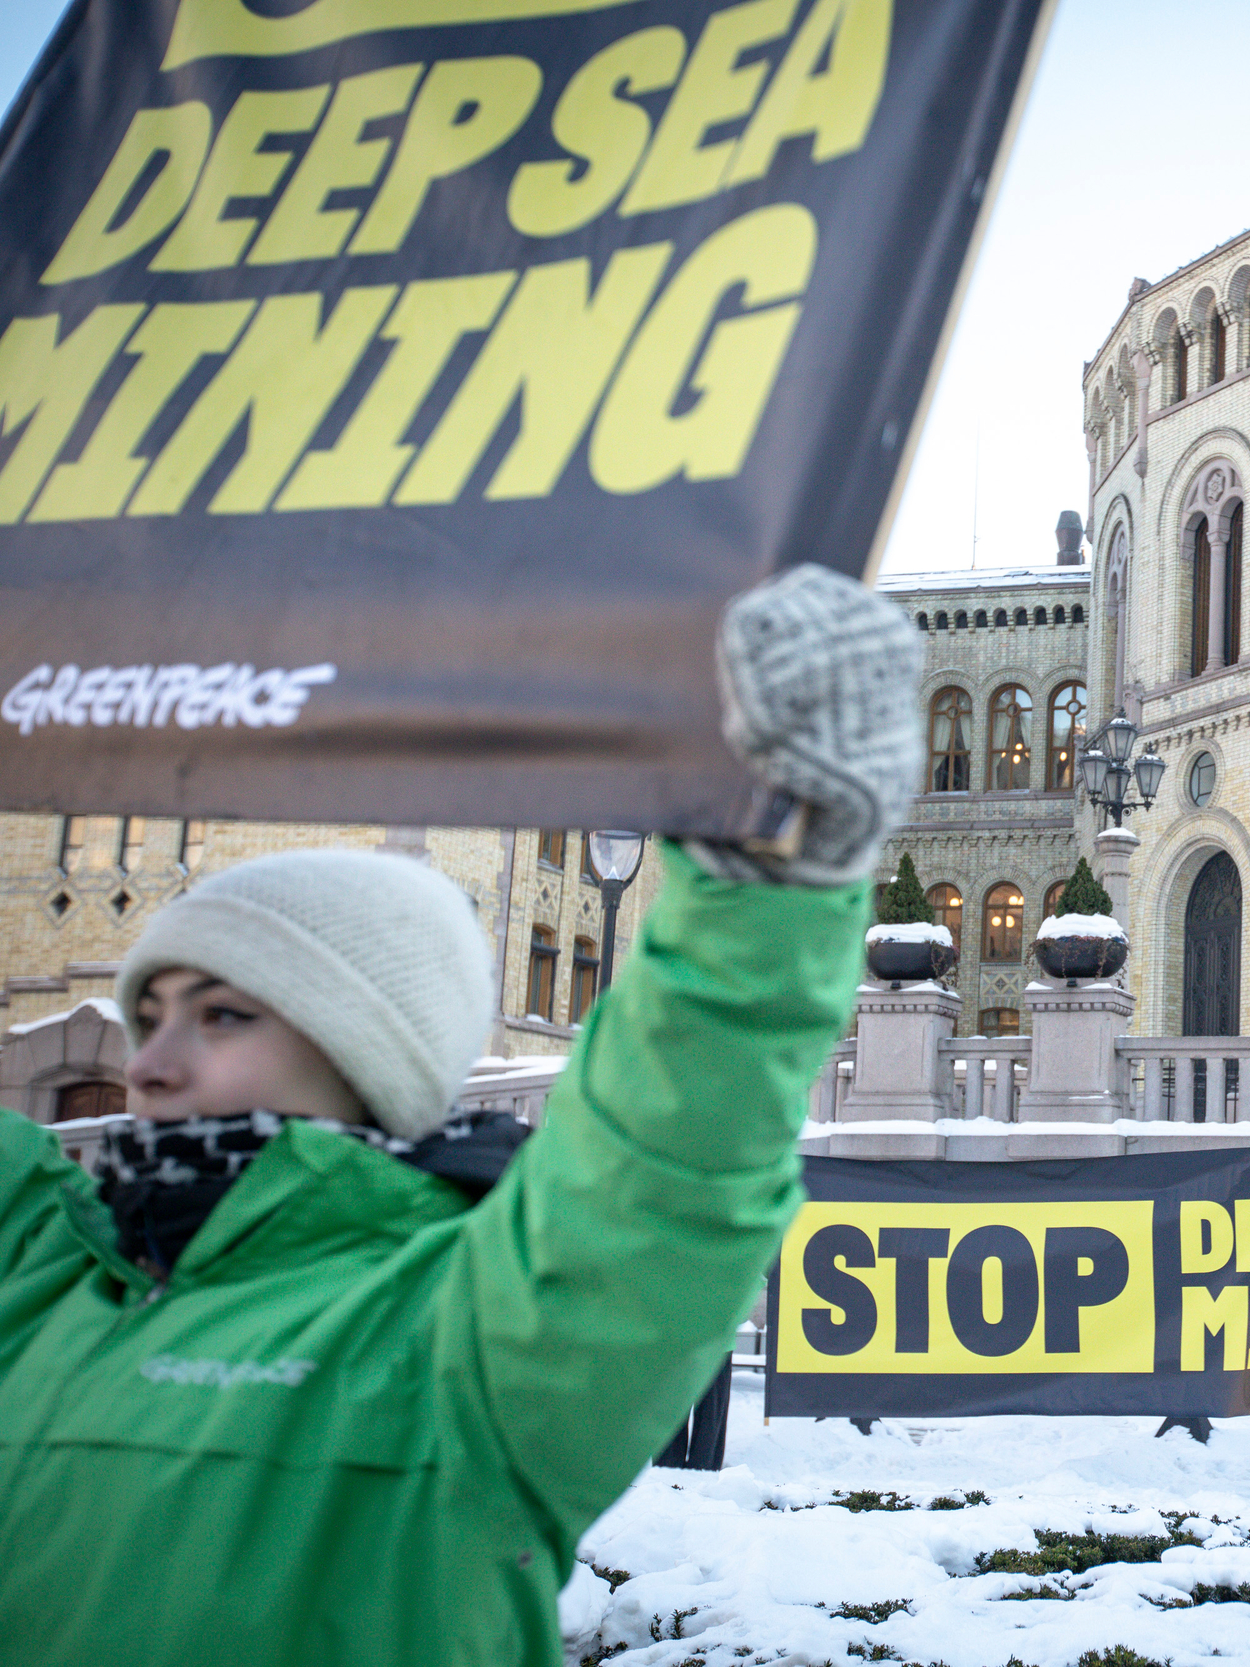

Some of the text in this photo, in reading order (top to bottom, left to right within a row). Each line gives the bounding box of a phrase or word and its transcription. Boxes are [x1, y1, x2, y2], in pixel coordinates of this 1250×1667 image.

[39, 0, 893, 285] DEEP SEA
[0, 203, 817, 525] MINING
[1, 662, 337, 736] GREENPEACE
[801, 1224, 1130, 1357] STOP
